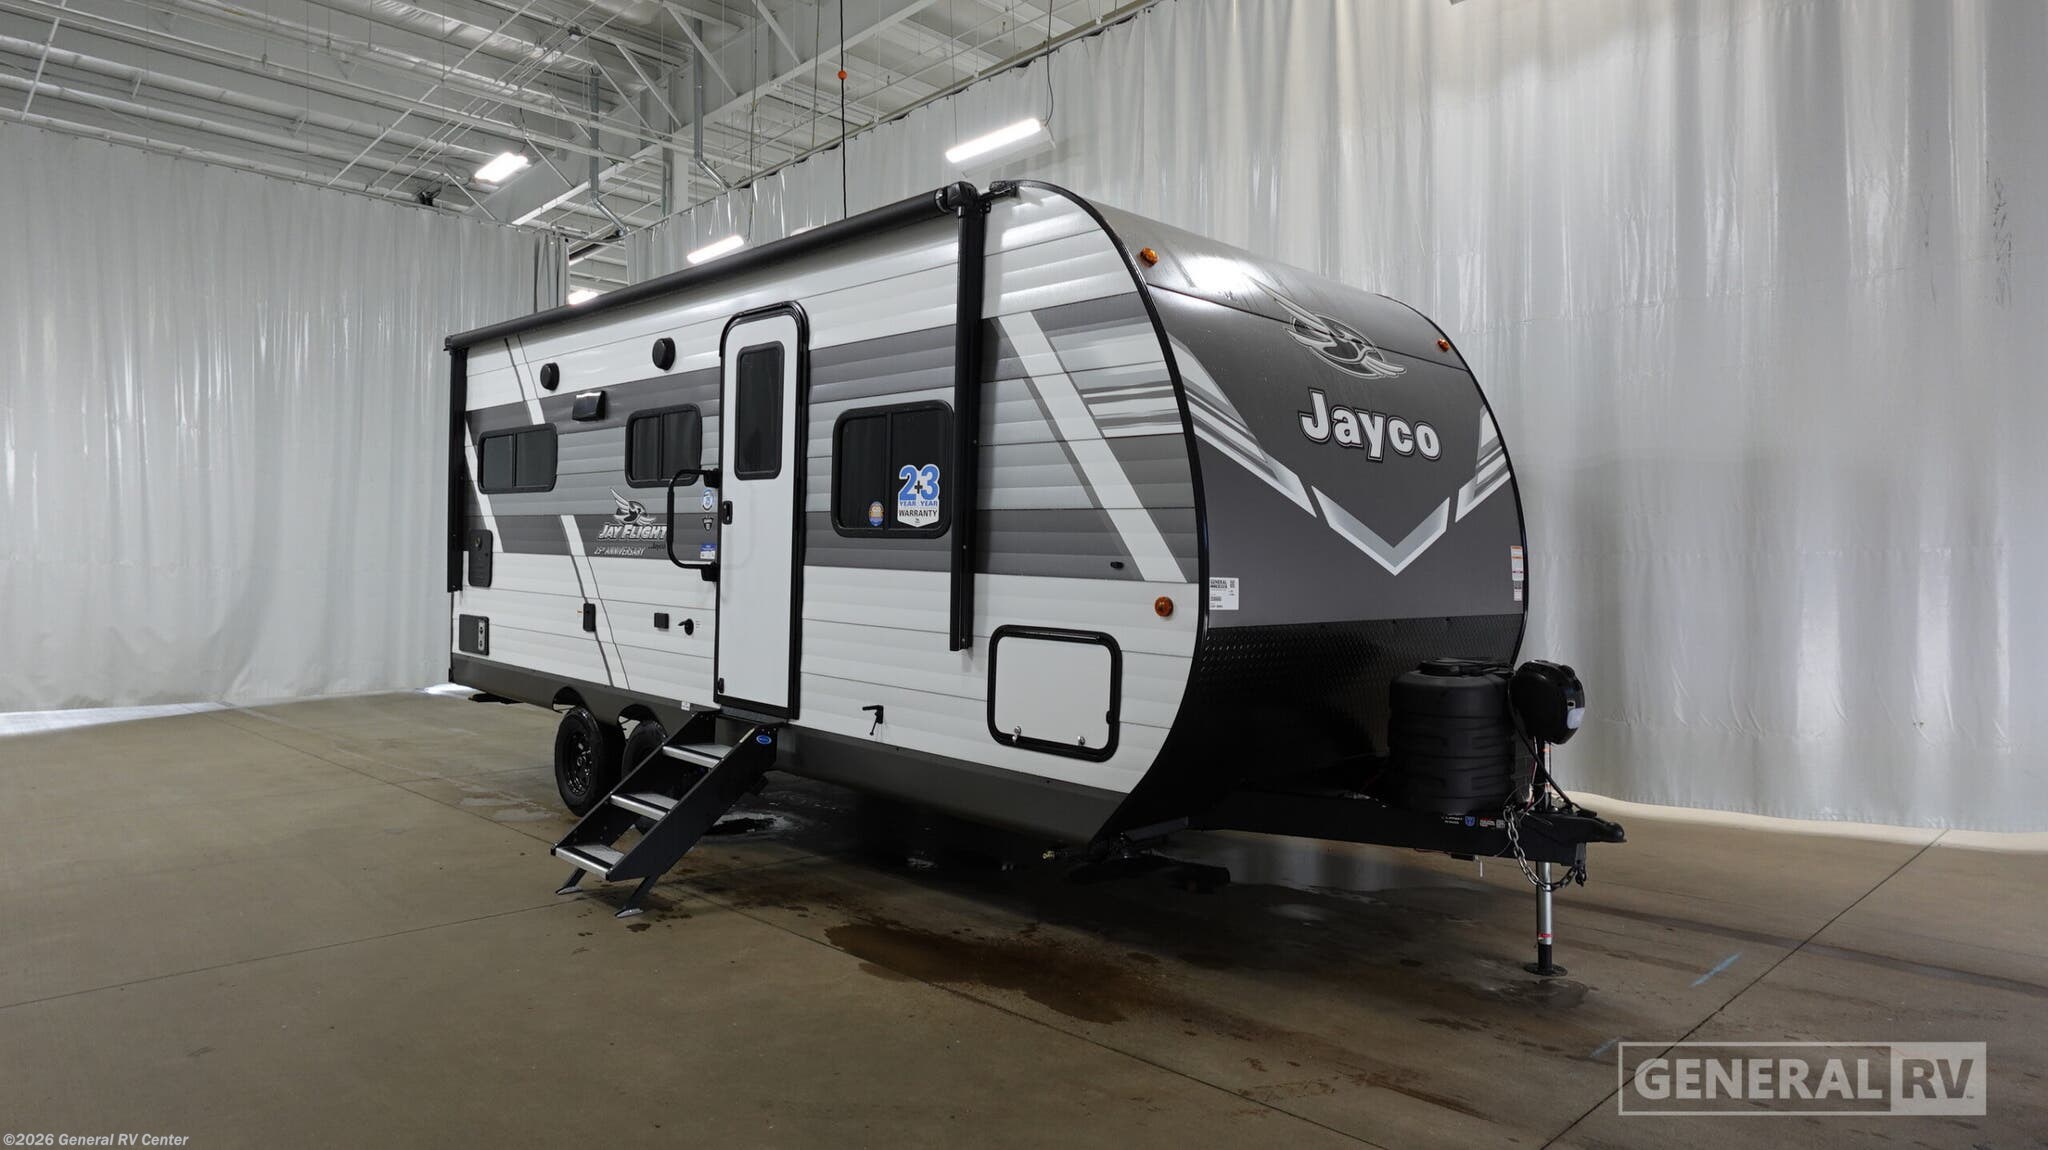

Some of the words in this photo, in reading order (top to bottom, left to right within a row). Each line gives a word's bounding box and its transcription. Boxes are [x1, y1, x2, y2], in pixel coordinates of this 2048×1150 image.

[1299, 388, 1442, 461] Jayco
[899, 509, 938, 518] WARRANTY
[599, 524, 621, 540] JAY
[621, 524, 667, 540] FLIGHT
